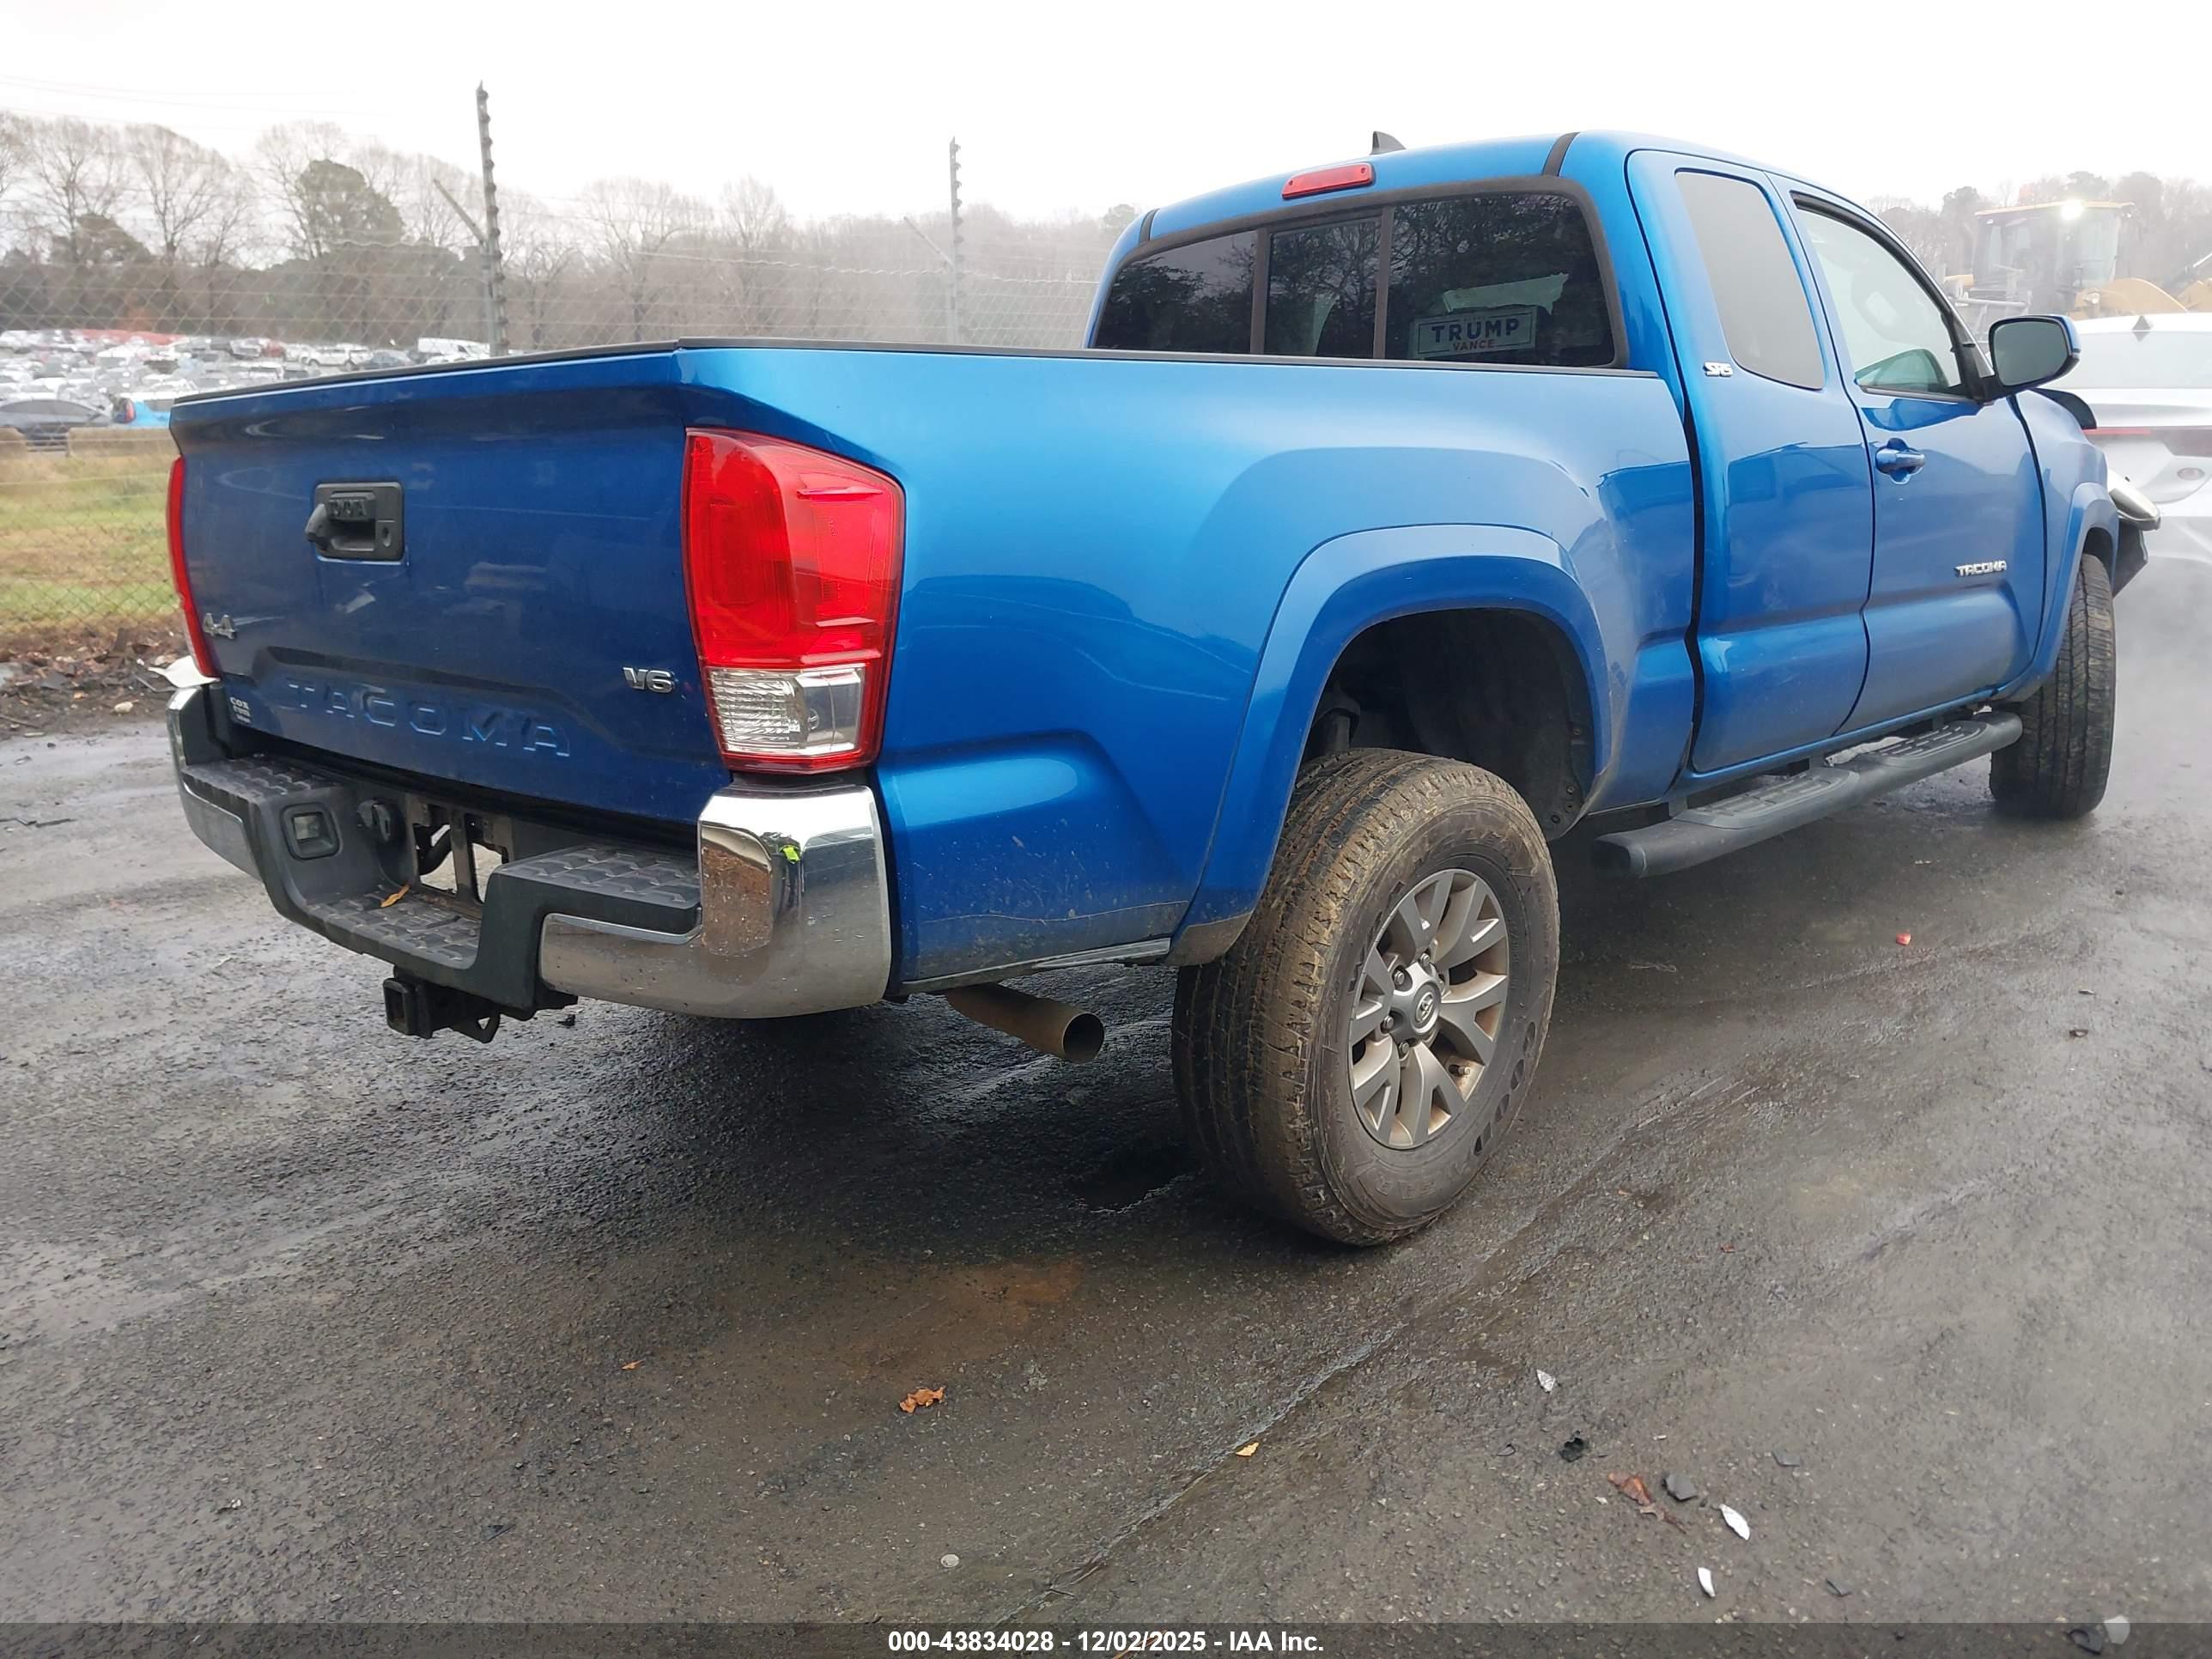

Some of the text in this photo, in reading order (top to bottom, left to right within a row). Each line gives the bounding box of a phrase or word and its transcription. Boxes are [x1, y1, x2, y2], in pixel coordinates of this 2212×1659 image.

[1431, 318, 1519, 343] TRUMP
[1453, 339, 1495, 351] VANCE
[1703, 361, 1733, 377] SR5
[1954, 560, 2008, 577] TACOMA
[623, 666, 672, 694] V6
[284, 677, 570, 757] TACOMA
